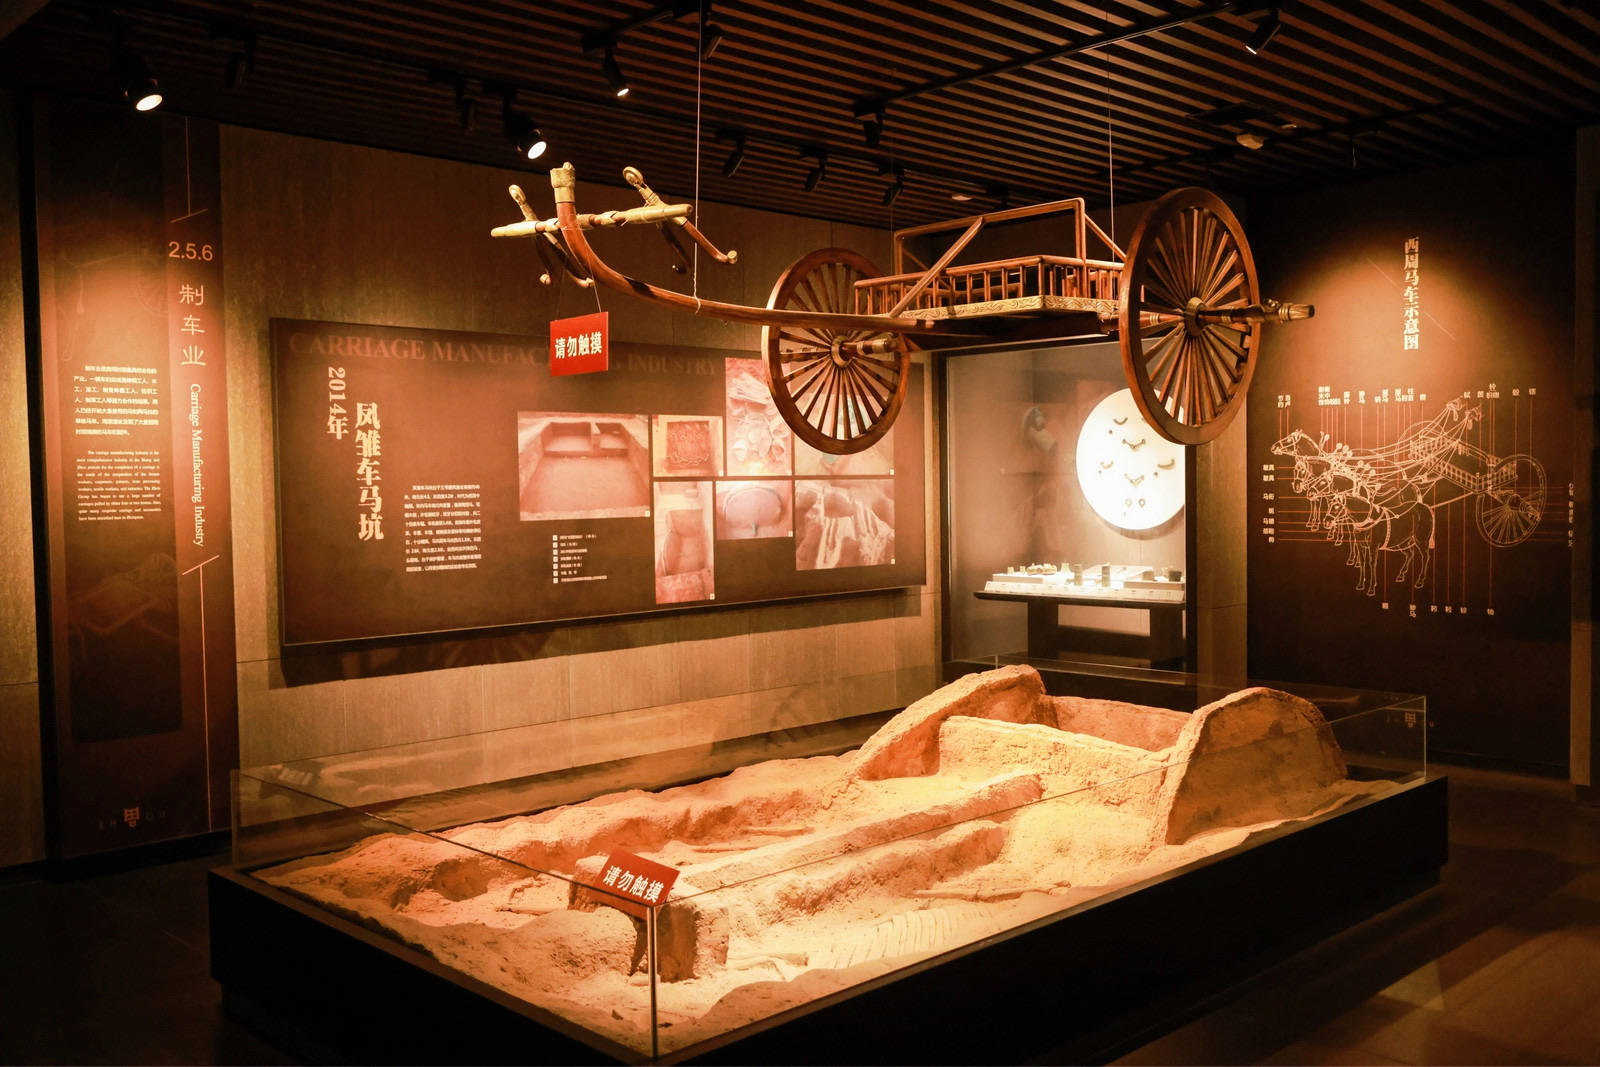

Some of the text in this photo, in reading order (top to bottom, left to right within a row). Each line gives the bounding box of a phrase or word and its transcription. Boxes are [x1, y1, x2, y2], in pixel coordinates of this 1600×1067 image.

[168, 241, 213, 261] 2.5.6
[1404, 237, 1420, 350] 西周马车示意图
[179, 283, 207, 366] 制车业
[288, 333, 425, 361] CARRIAGE
[555, 331, 602, 359] 请勿触摸
[189, 383, 206, 547] Carriage Manufacturing Industry
[355, 402, 385, 541] 凤雏车马坑
[602, 865, 665, 904] 请勿触摸
